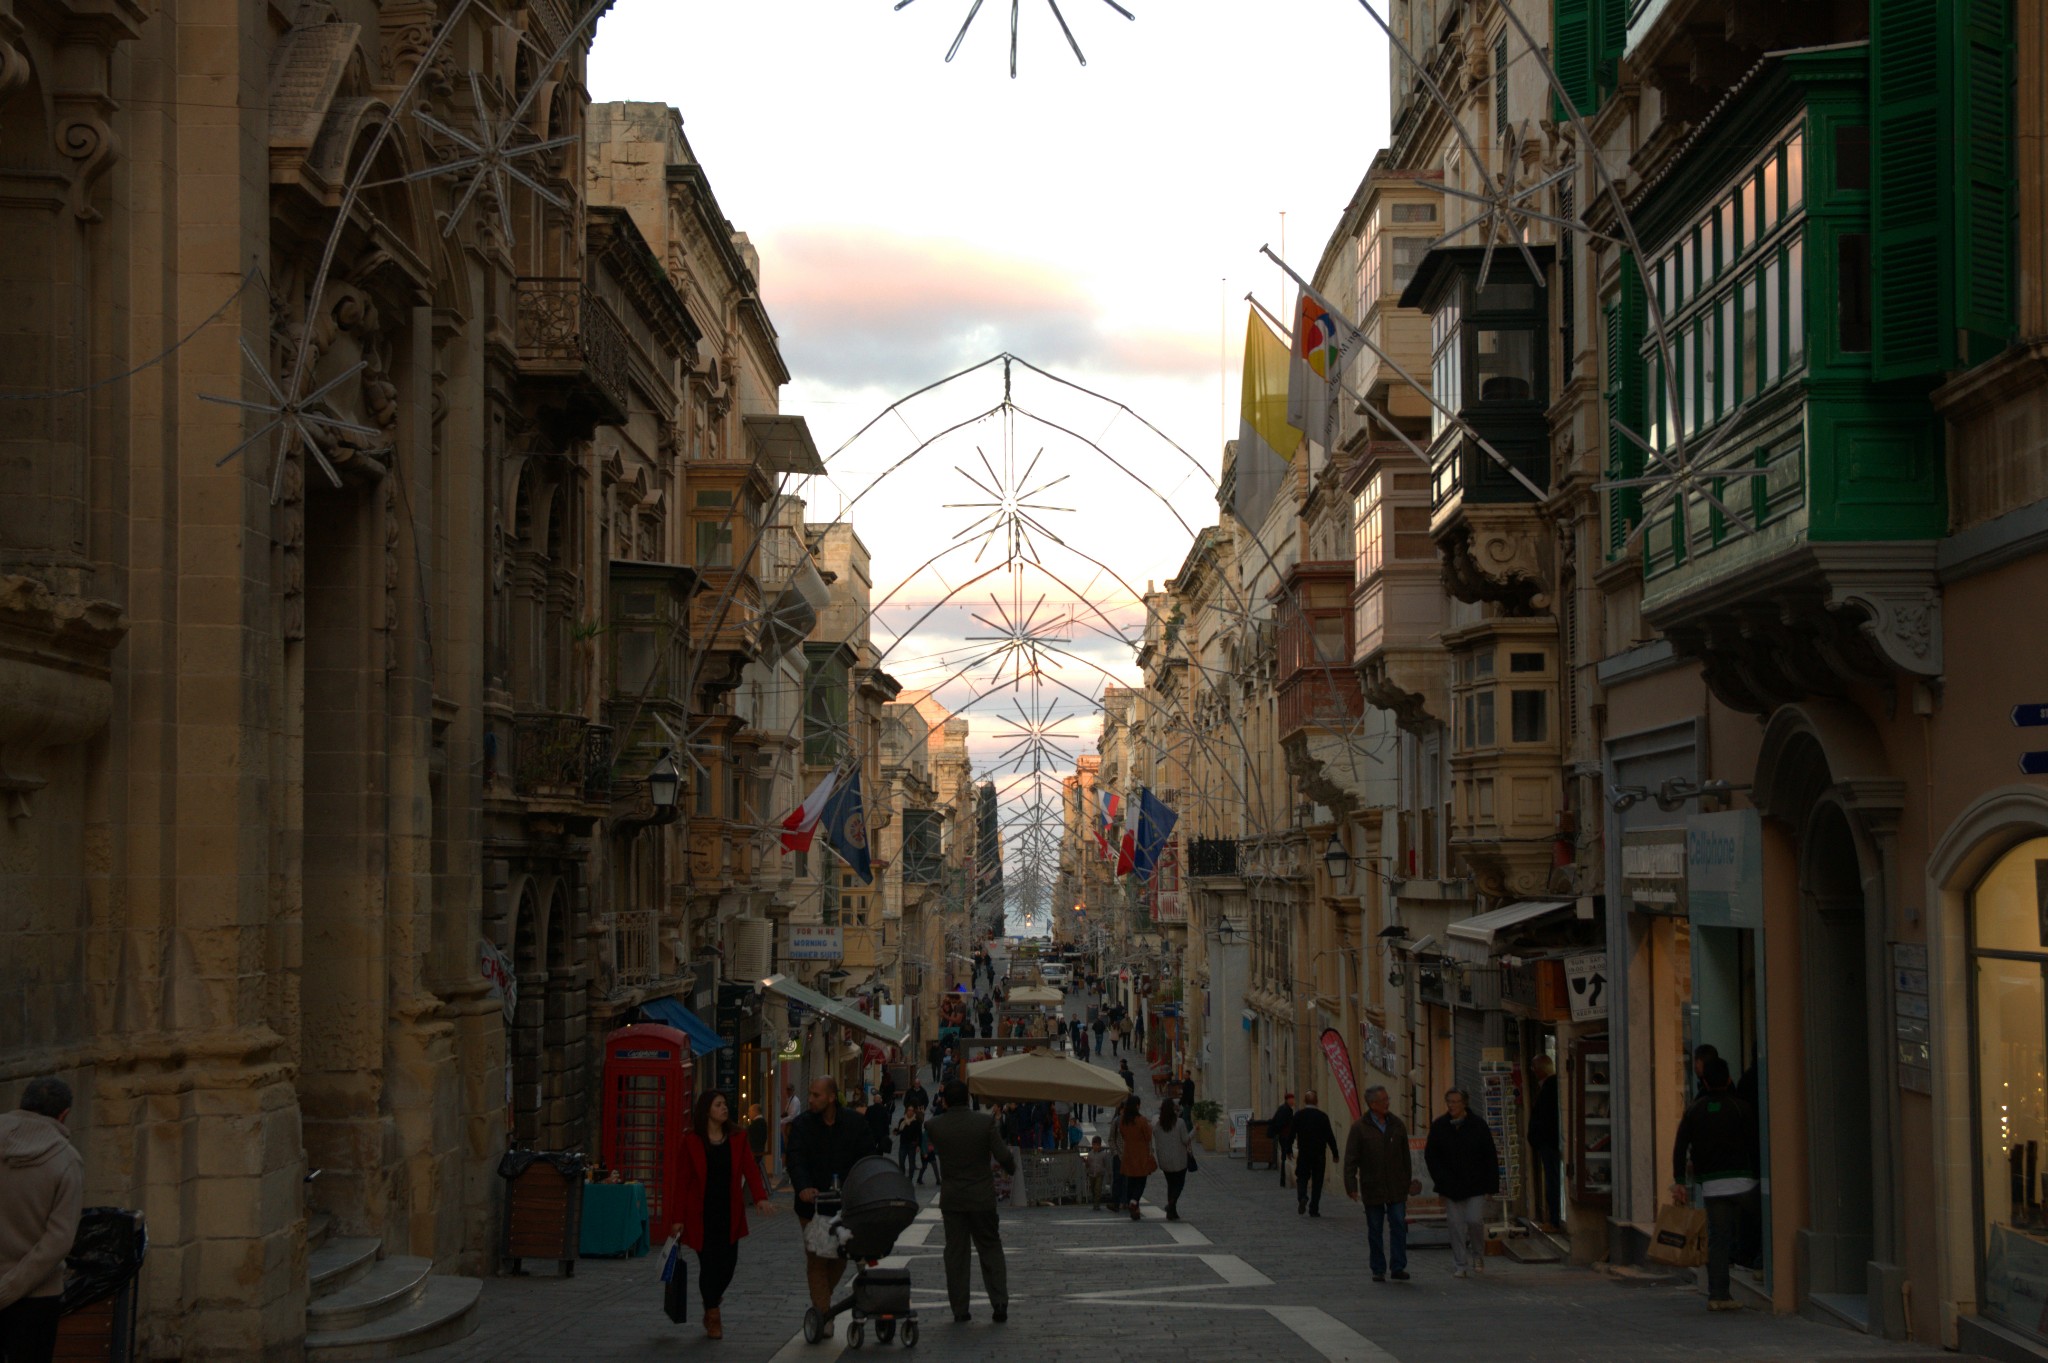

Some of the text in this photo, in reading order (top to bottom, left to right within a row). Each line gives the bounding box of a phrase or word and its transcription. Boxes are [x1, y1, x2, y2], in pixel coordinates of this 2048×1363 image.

[1690, 831, 1735, 873] Cellphone
[820, 951, 841, 959] SUITS
[1576, 1007, 1608, 1017] KEEP RIGH
